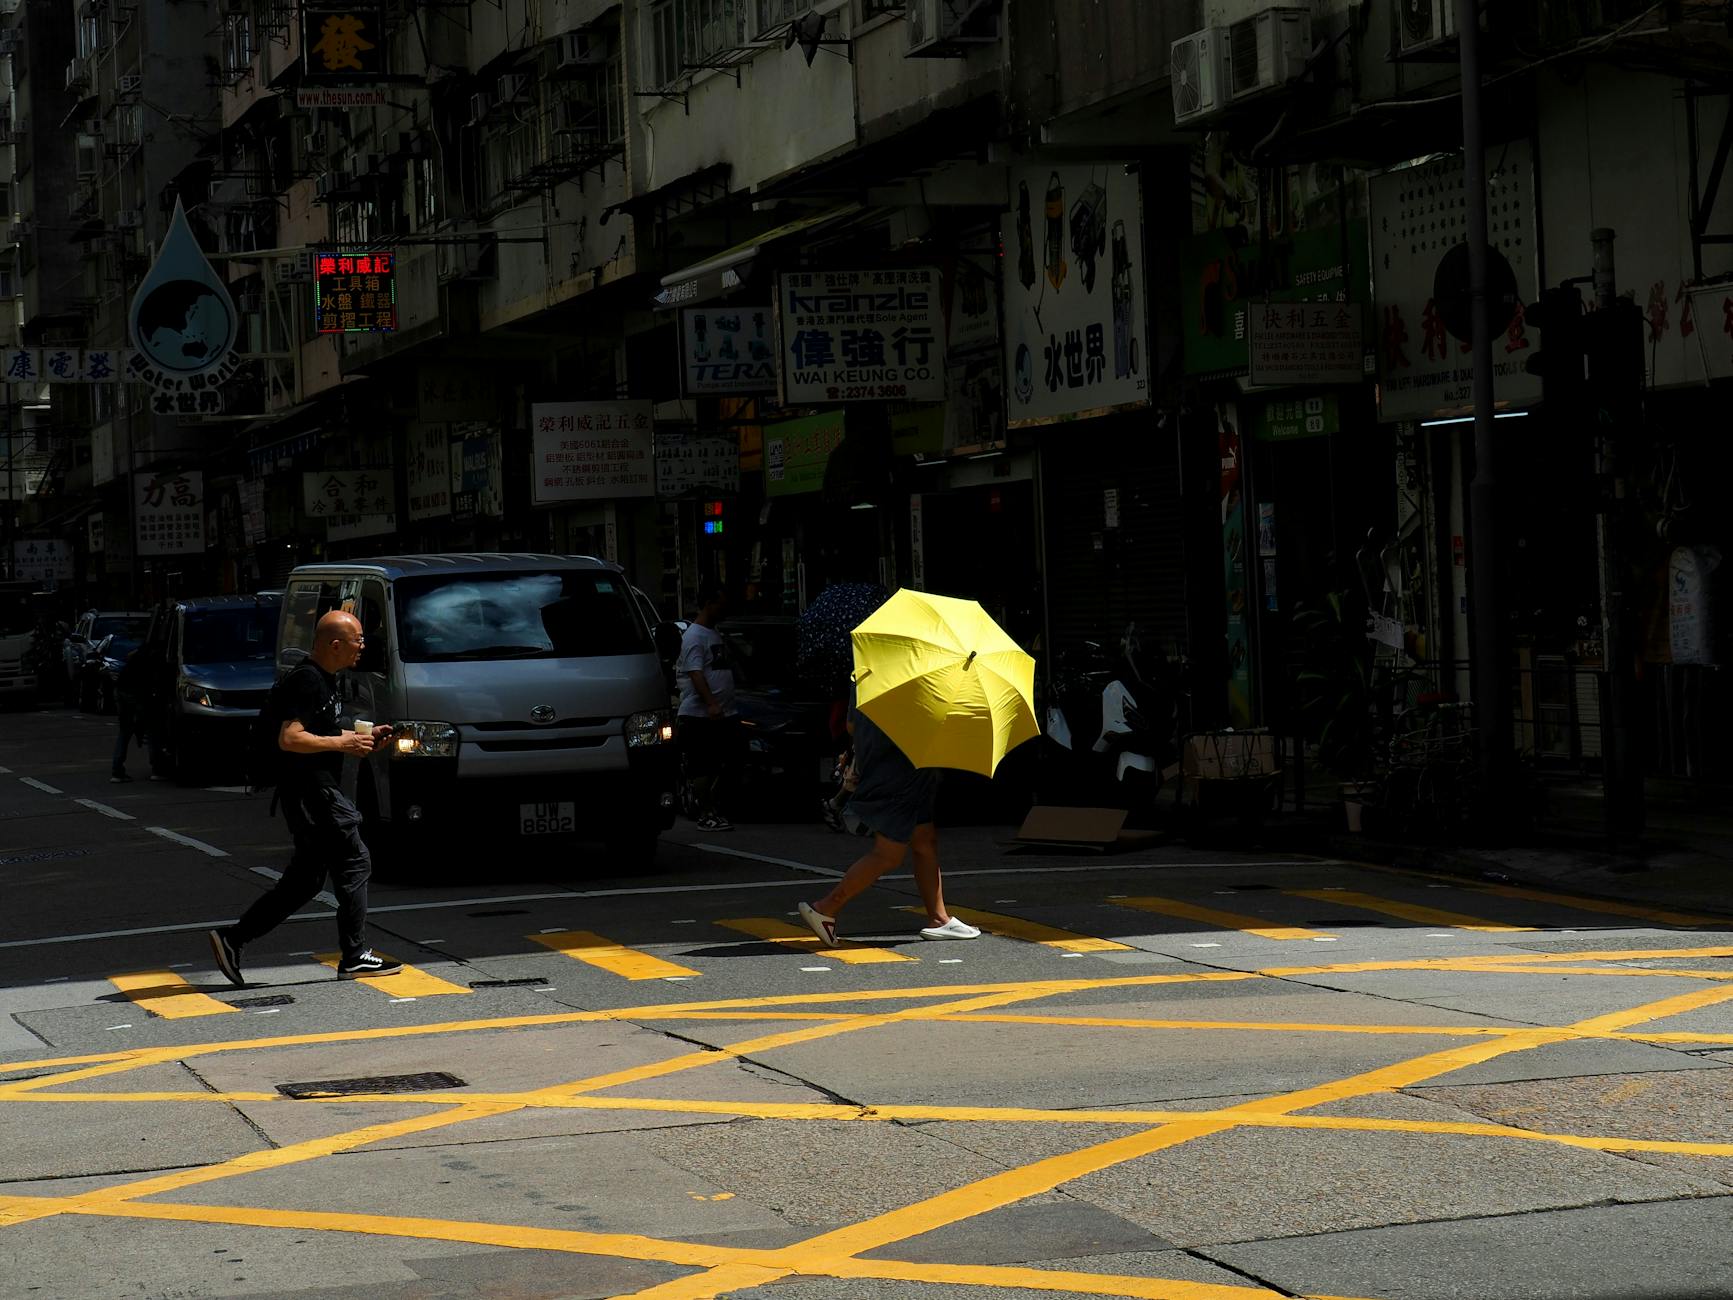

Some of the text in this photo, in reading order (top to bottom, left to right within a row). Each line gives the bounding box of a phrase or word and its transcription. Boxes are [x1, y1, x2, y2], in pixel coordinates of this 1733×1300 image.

[299, 90, 386, 105] www.thesun.com.hk
[332, 276, 380, 292] 工具箱
[877, 314, 897, 322] Sole
[900, 313, 928, 323] Agent
[1263, 308, 1352, 329] 快利五金
[1384, 298, 1530, 368] 快利金
[791, 329, 935, 369] 偉強行
[1045, 323, 1105, 393] 水世界
[130, 351, 239, 392] Water World
[794, 367, 935, 385] WAI KEUNG CO.
[154, 391, 219, 413] 水世界
[540, 413, 649, 433] 榮利威記五金
[322, 474, 379, 498] 合和
[312, 496, 391, 514] 冷氣零件
[535, 803, 560, 818] UW
[523, 816, 573, 833] 8602
